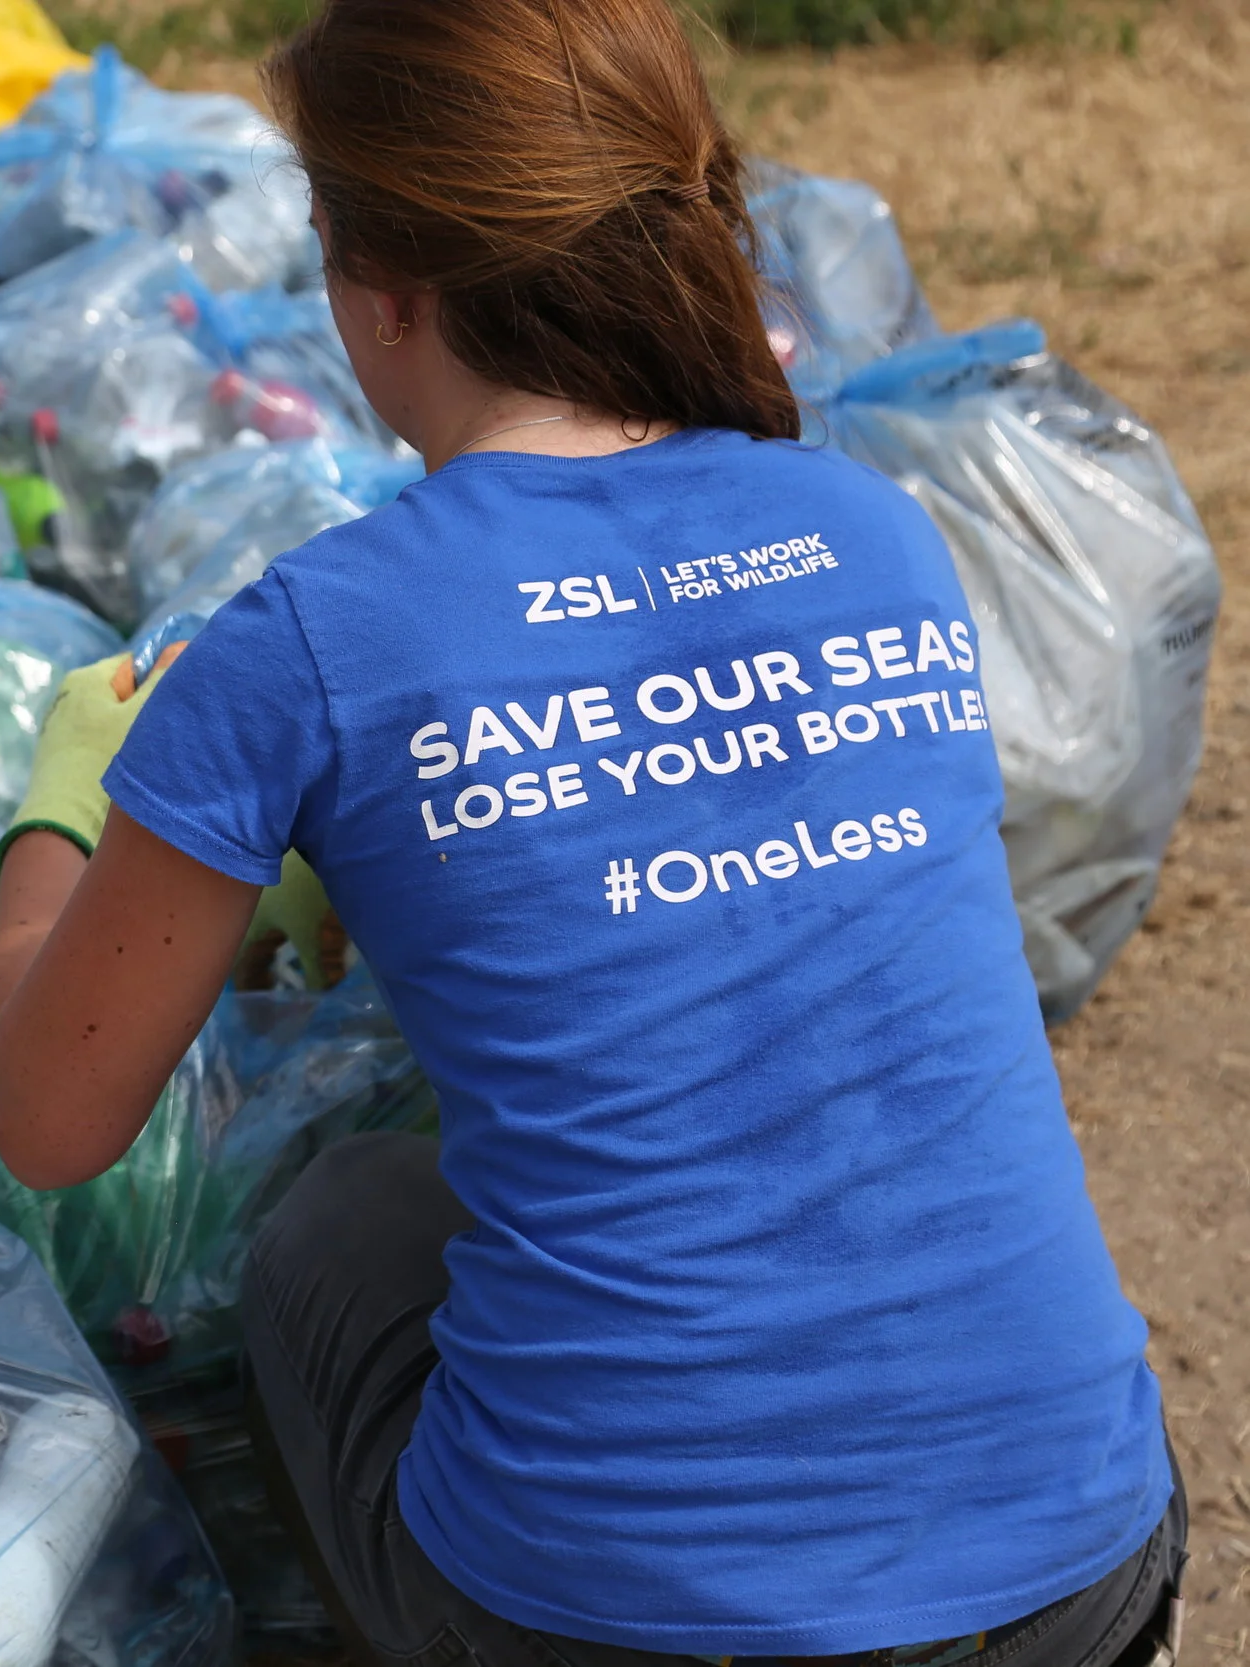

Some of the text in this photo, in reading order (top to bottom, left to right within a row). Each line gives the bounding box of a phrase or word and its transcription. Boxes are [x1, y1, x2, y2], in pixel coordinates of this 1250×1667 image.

[517, 574, 638, 624] ZSL
[659, 532, 828, 585] LET'S WORK
[668, 550, 840, 604] FOR WILDLIFE
[409, 619, 976, 780] SAVE OUR SEAS
[420, 762, 590, 842] LOSE
[597, 722, 790, 797] YOUR
[603, 806, 929, 916] #OneLess
